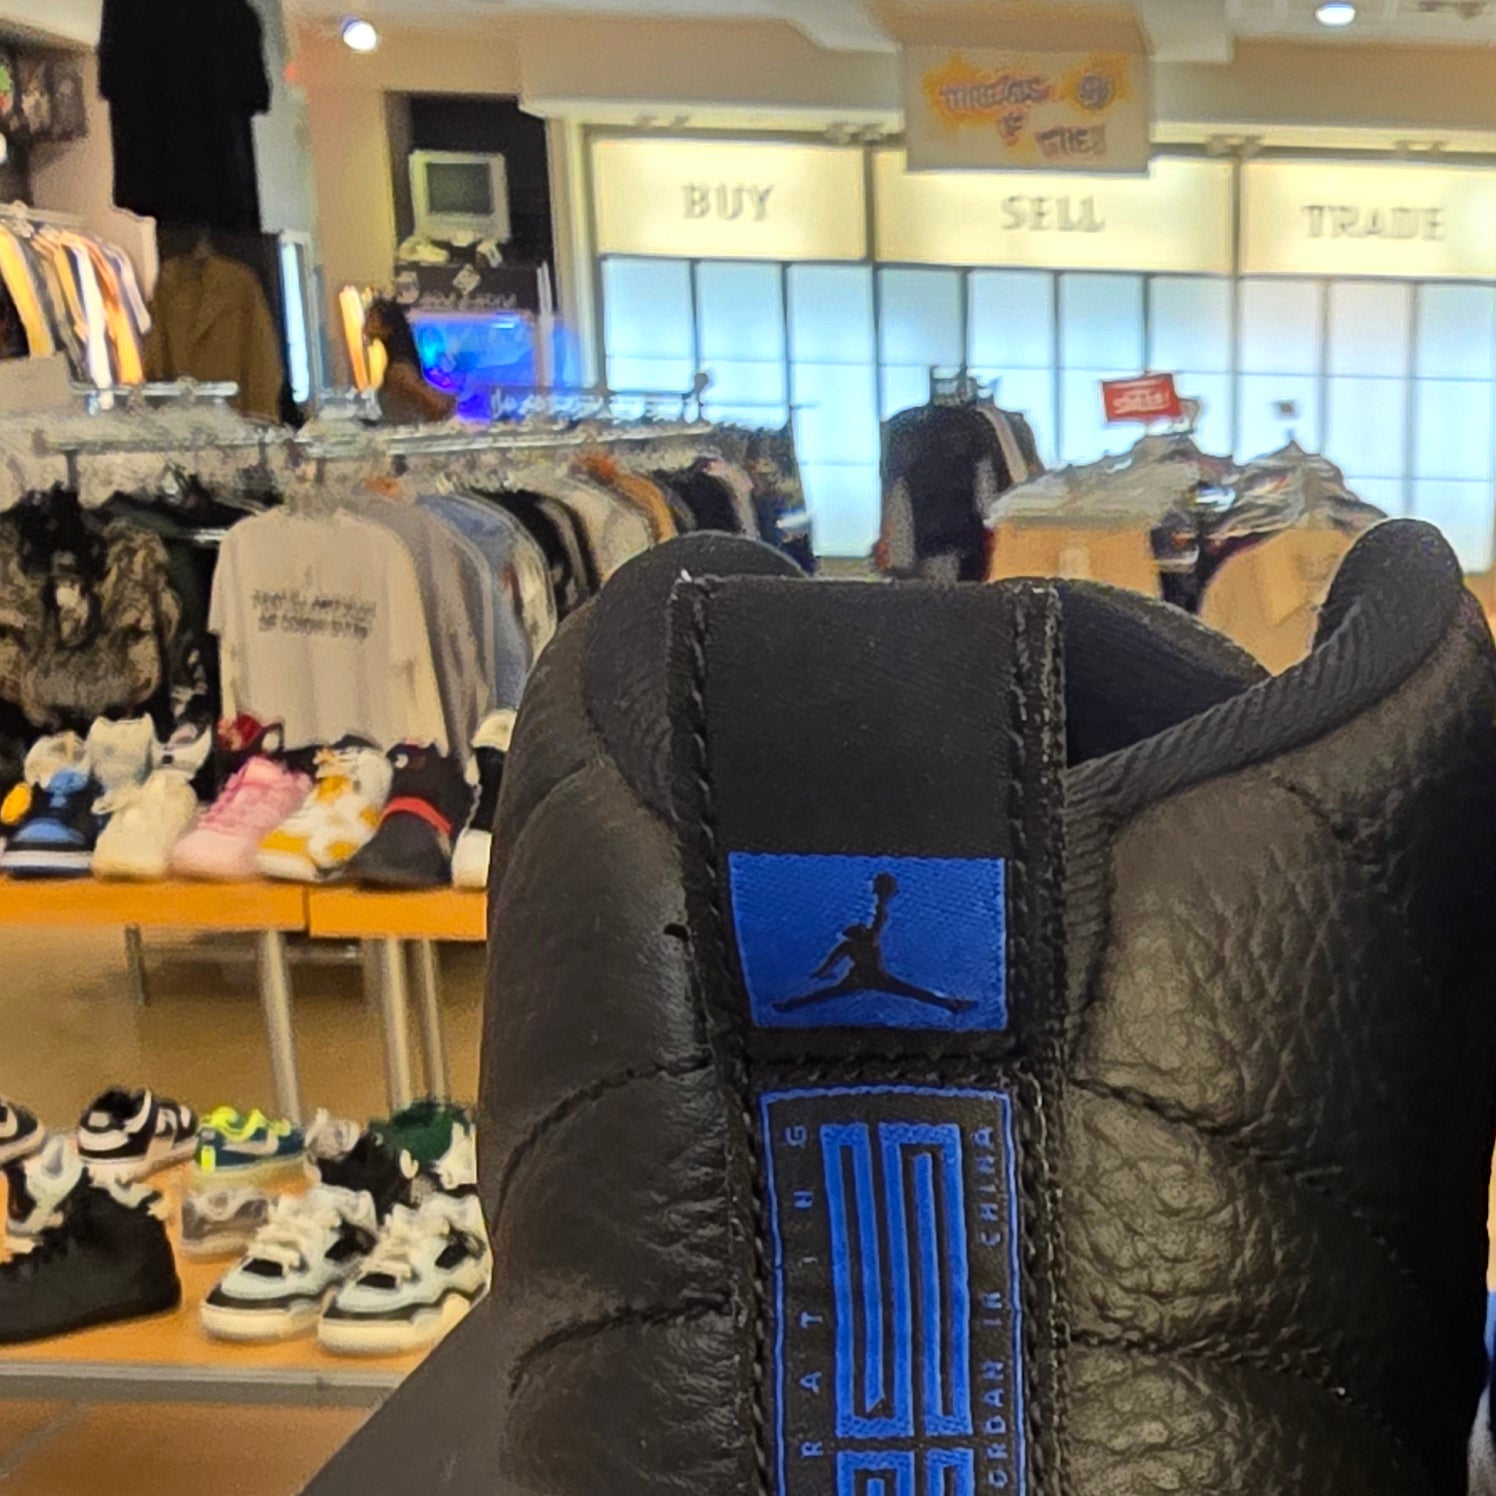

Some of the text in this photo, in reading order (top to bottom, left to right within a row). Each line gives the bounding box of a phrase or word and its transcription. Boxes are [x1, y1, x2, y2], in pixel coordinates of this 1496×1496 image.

[681, 181, 775, 222] BUY
[1001, 195, 1107, 233] SELL
[1301, 204, 1447, 241] TRADE
[972, 1125, 1002, 1247] CHINA
[981, 1291, 1003, 1326] IN
